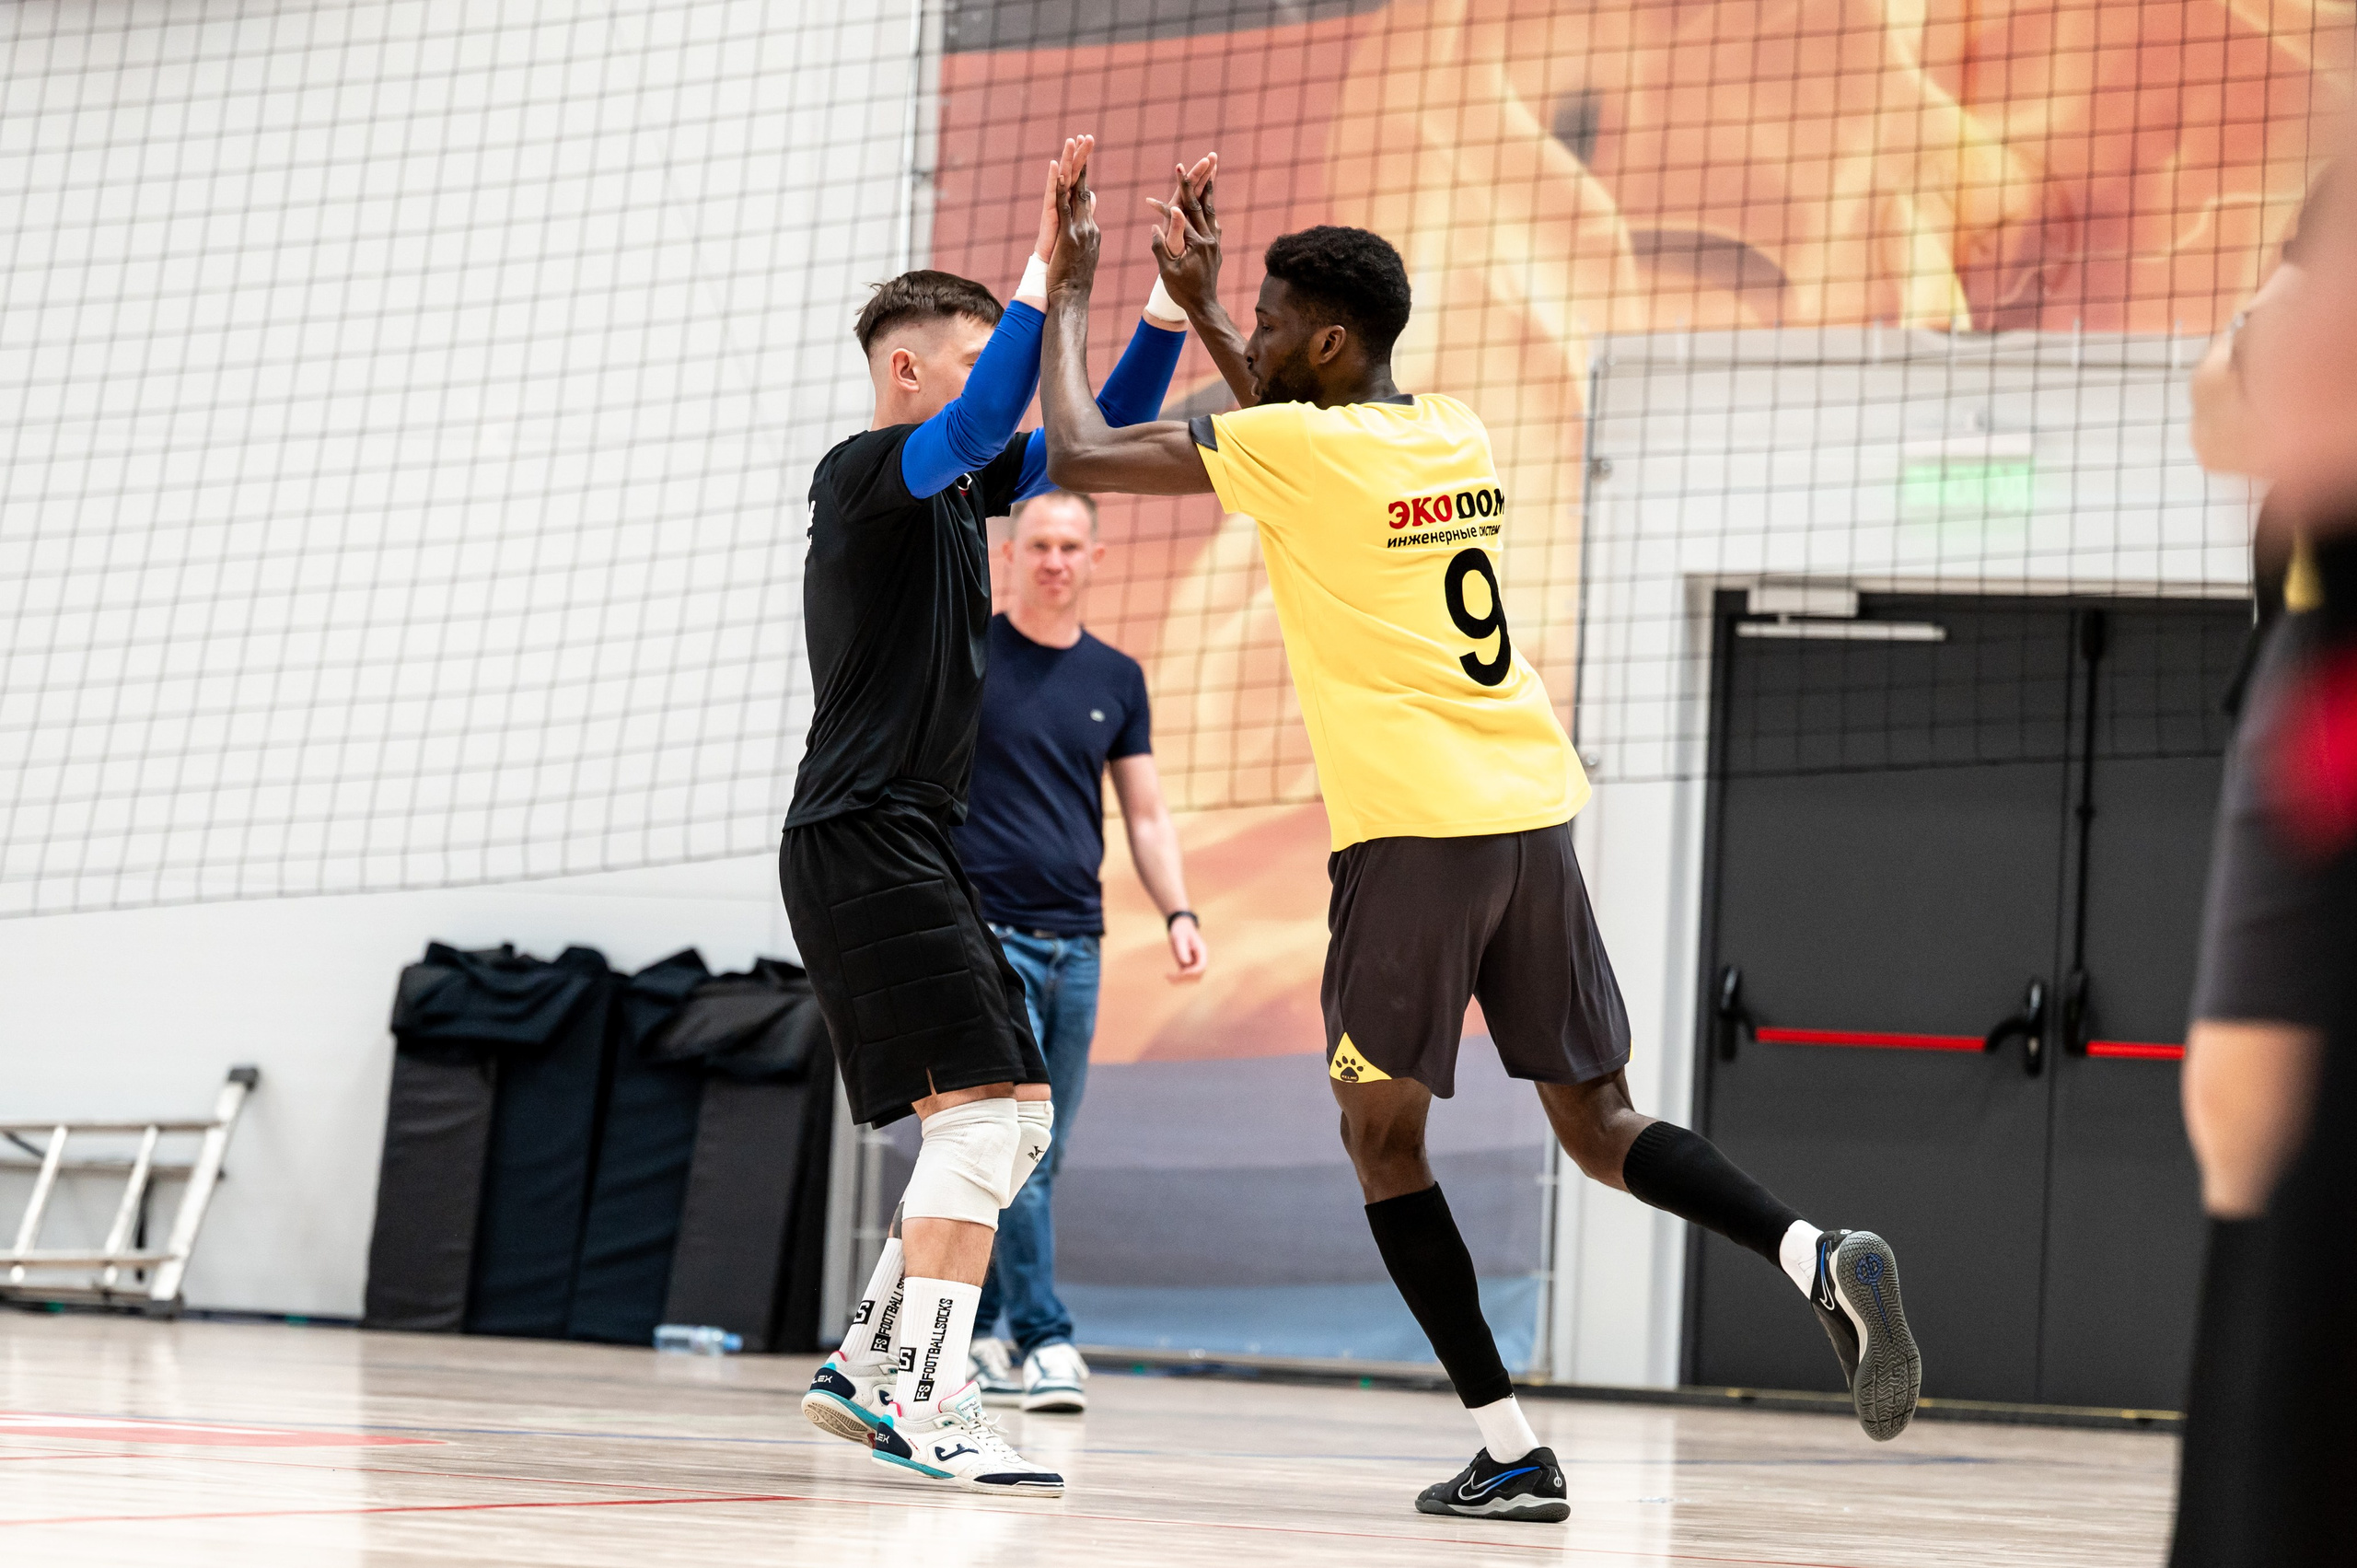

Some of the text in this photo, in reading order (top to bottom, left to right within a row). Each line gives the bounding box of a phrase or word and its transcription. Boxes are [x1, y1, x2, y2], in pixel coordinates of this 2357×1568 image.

[1387, 524, 1502, 549] инженерные систем
[1445, 548, 1511, 687] 9
[916, 1297, 954, 1400] FS FOOTBALLSOCKS
